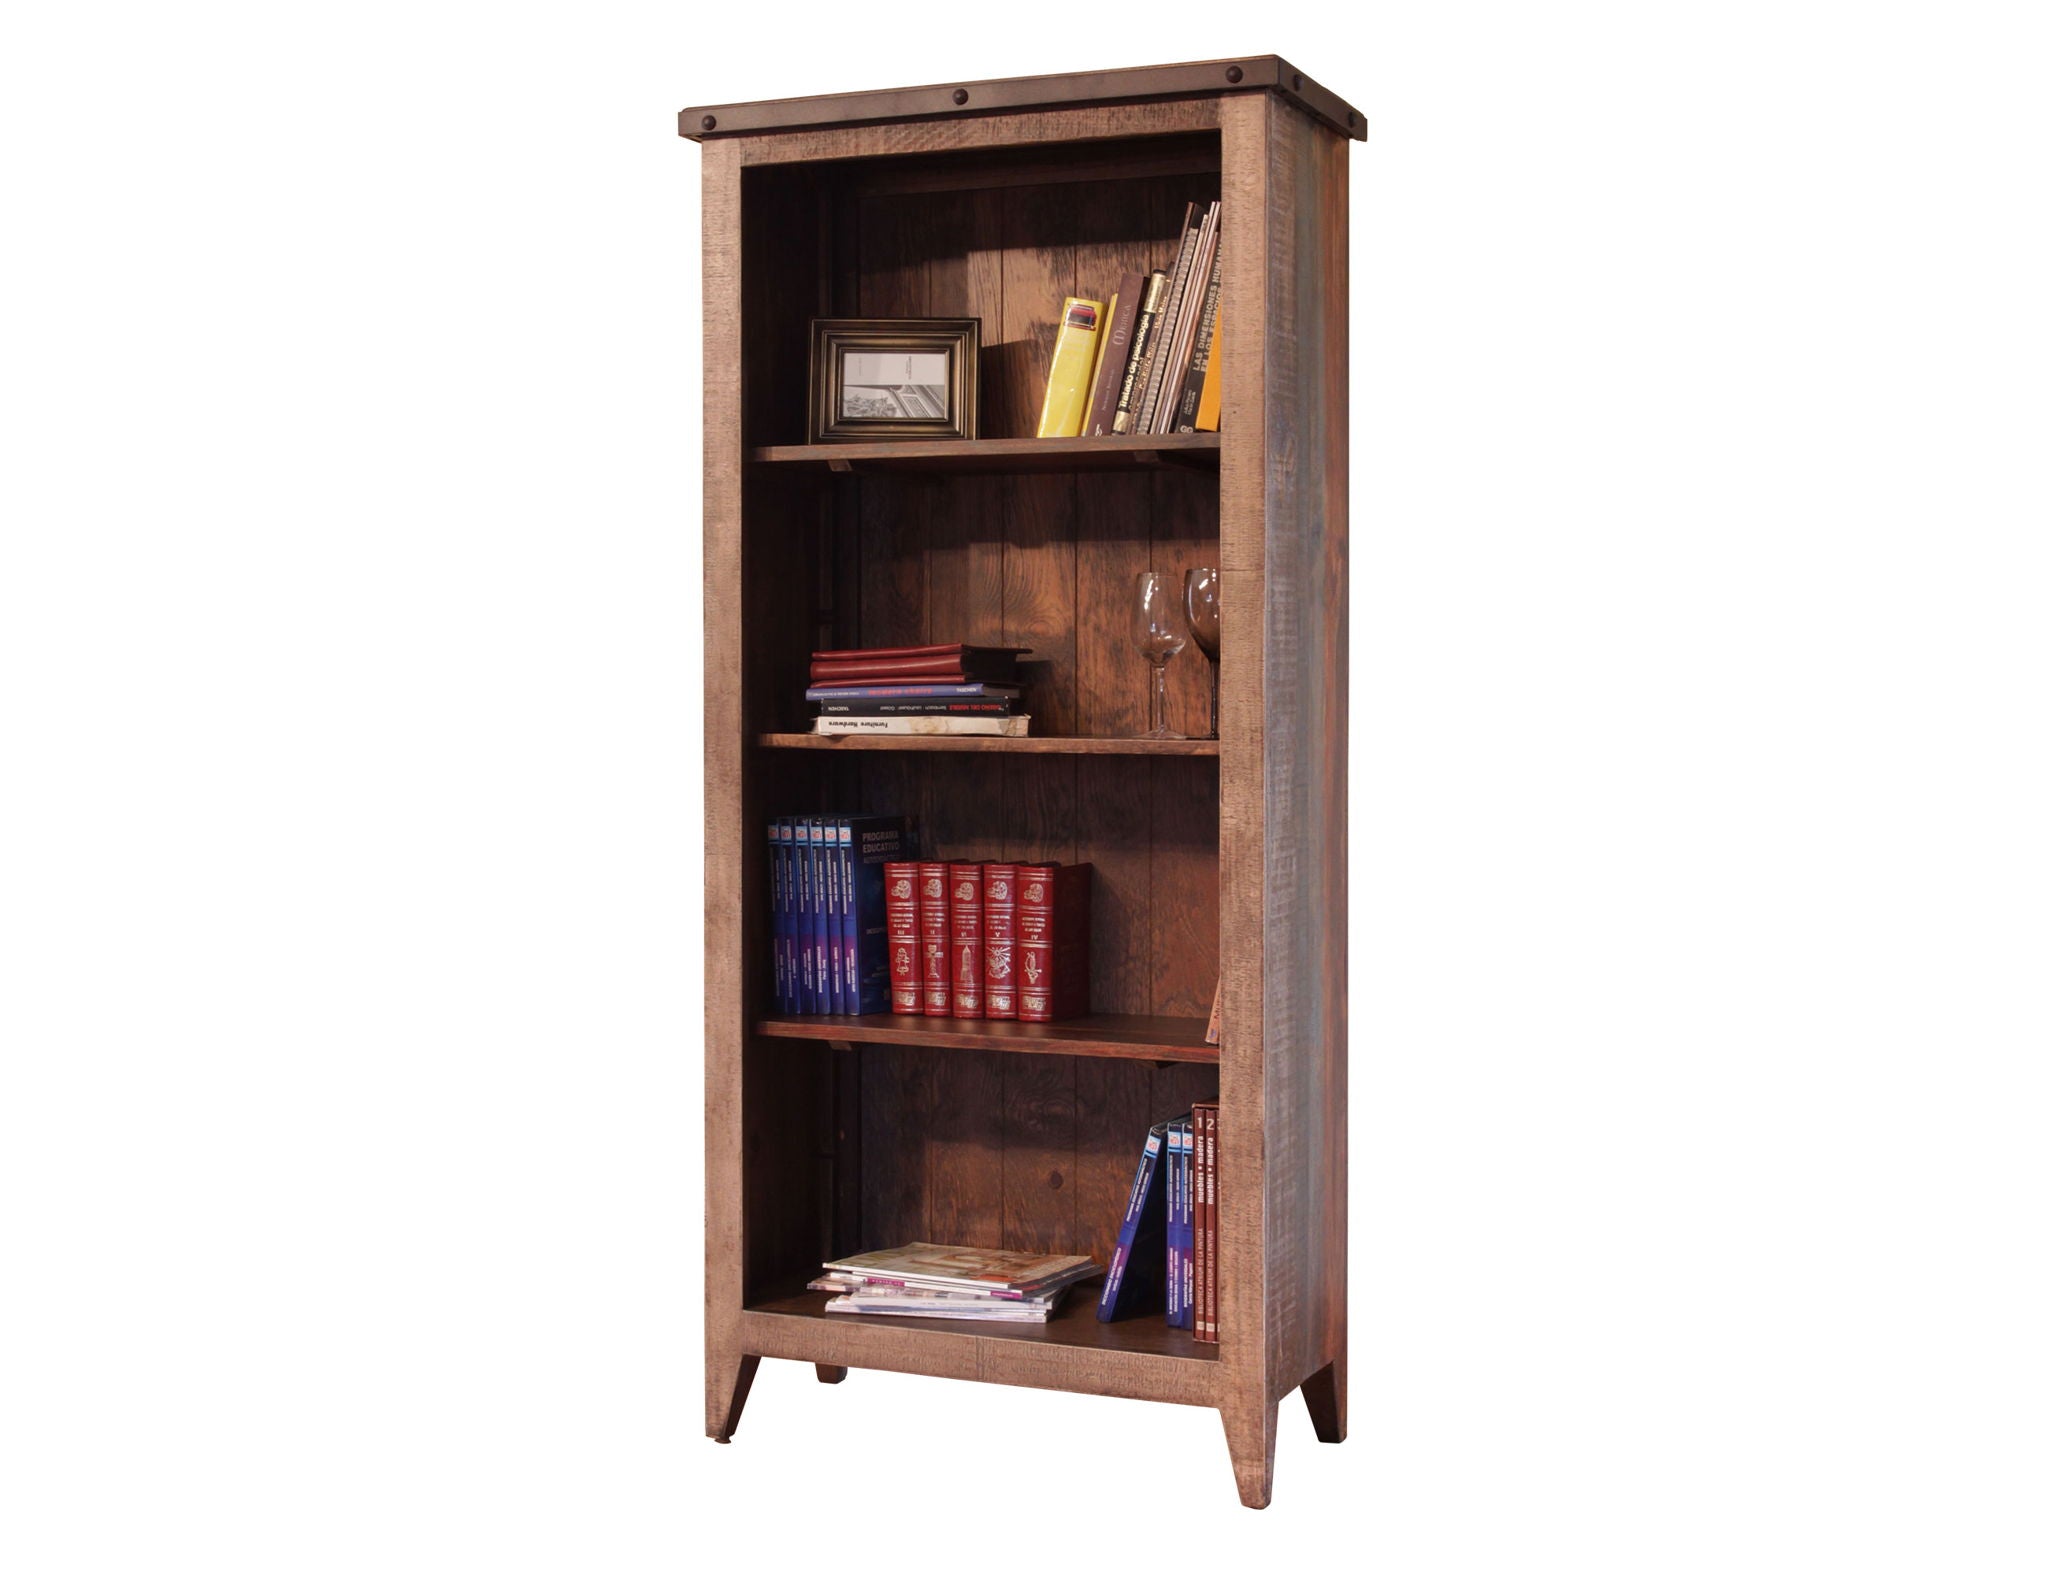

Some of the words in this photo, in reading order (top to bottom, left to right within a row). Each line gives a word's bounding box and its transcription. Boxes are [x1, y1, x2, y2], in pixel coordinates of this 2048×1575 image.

[1192, 353, 1203, 371] LAS
[1198, 285, 1218, 349] DIMENSIONES
[1118, 374, 1134, 408] Tratado
[1128, 361, 1138, 374] de
[828, 721, 858, 729] Hardware
[862, 830, 899, 843] PROGRAMA
[862, 842, 900, 853] EDUCATIVO
[1197, 1117, 1203, 1129] 1
[1206, 1118, 1215, 1130] 2
[1206, 1137, 1214, 1165] madera
[1206, 1174, 1214, 1205] muebles
